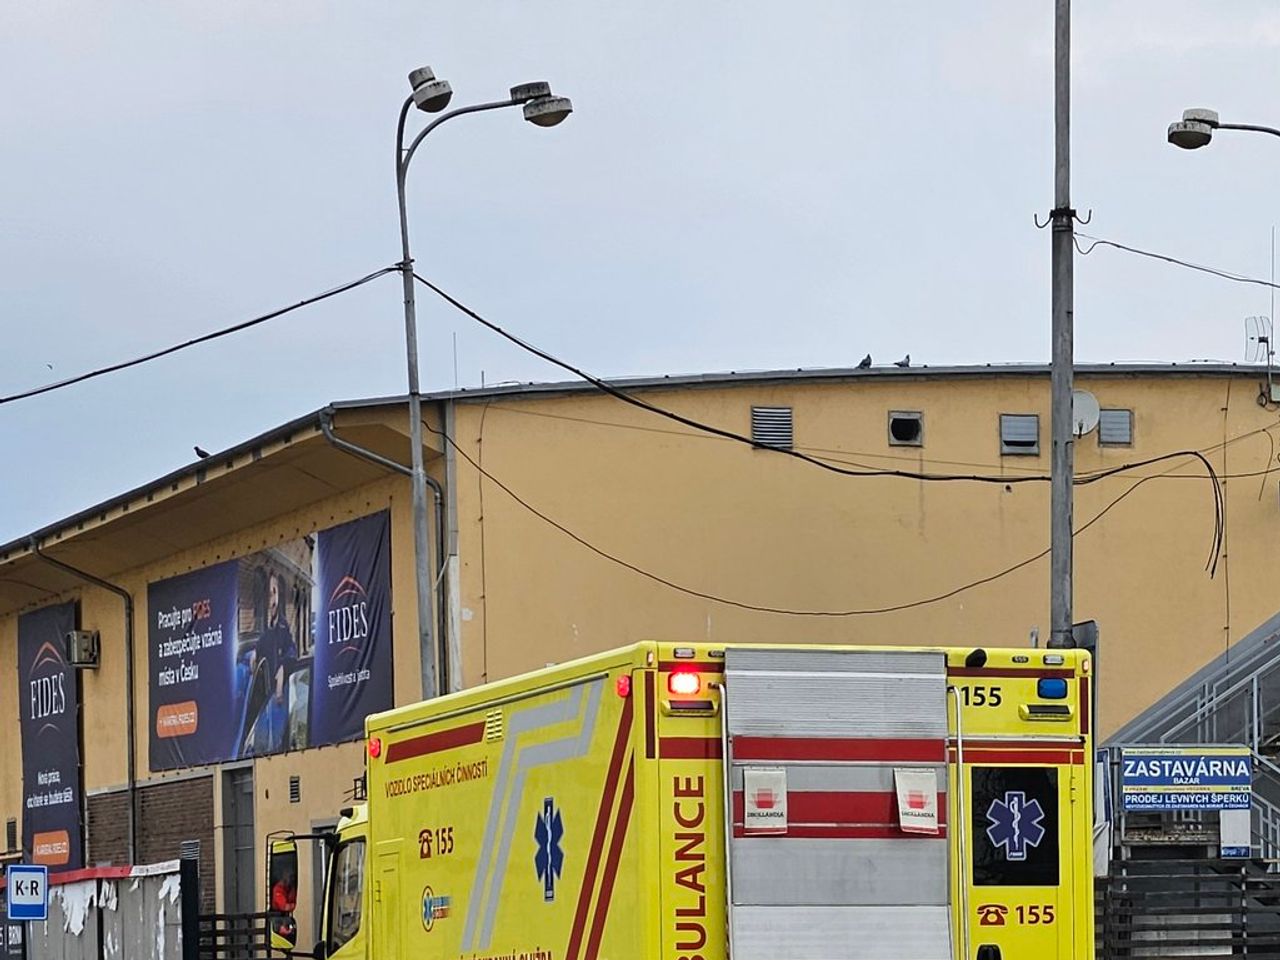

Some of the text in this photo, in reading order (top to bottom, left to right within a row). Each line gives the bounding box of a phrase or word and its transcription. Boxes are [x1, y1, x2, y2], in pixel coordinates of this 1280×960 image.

[158, 606, 181, 630] Pracujte
[181, 607, 192, 628] pro
[328, 601, 368, 644] FIDES
[163, 631, 201, 658] zabezpečujte
[201, 624, 223, 648] vzácná
[159, 665, 174, 686] místa
[180, 659, 199, 682] Česku
[30, 672, 65, 720] FIDES
[961, 686, 1002, 707] 155
[385, 756, 488, 798] VOZIDLO SPECIÁLNÍCH ČINNOSTÍ
[1123, 757, 1250, 777] ZASTAVÁRNA
[1173, 777, 1200, 785] BAZAR
[1125, 792, 1249, 804] PRODEJ LEVNÝCH ŠPERKŮ
[435, 827, 454, 855] 155
[1015, 905, 1055, 924] 155
